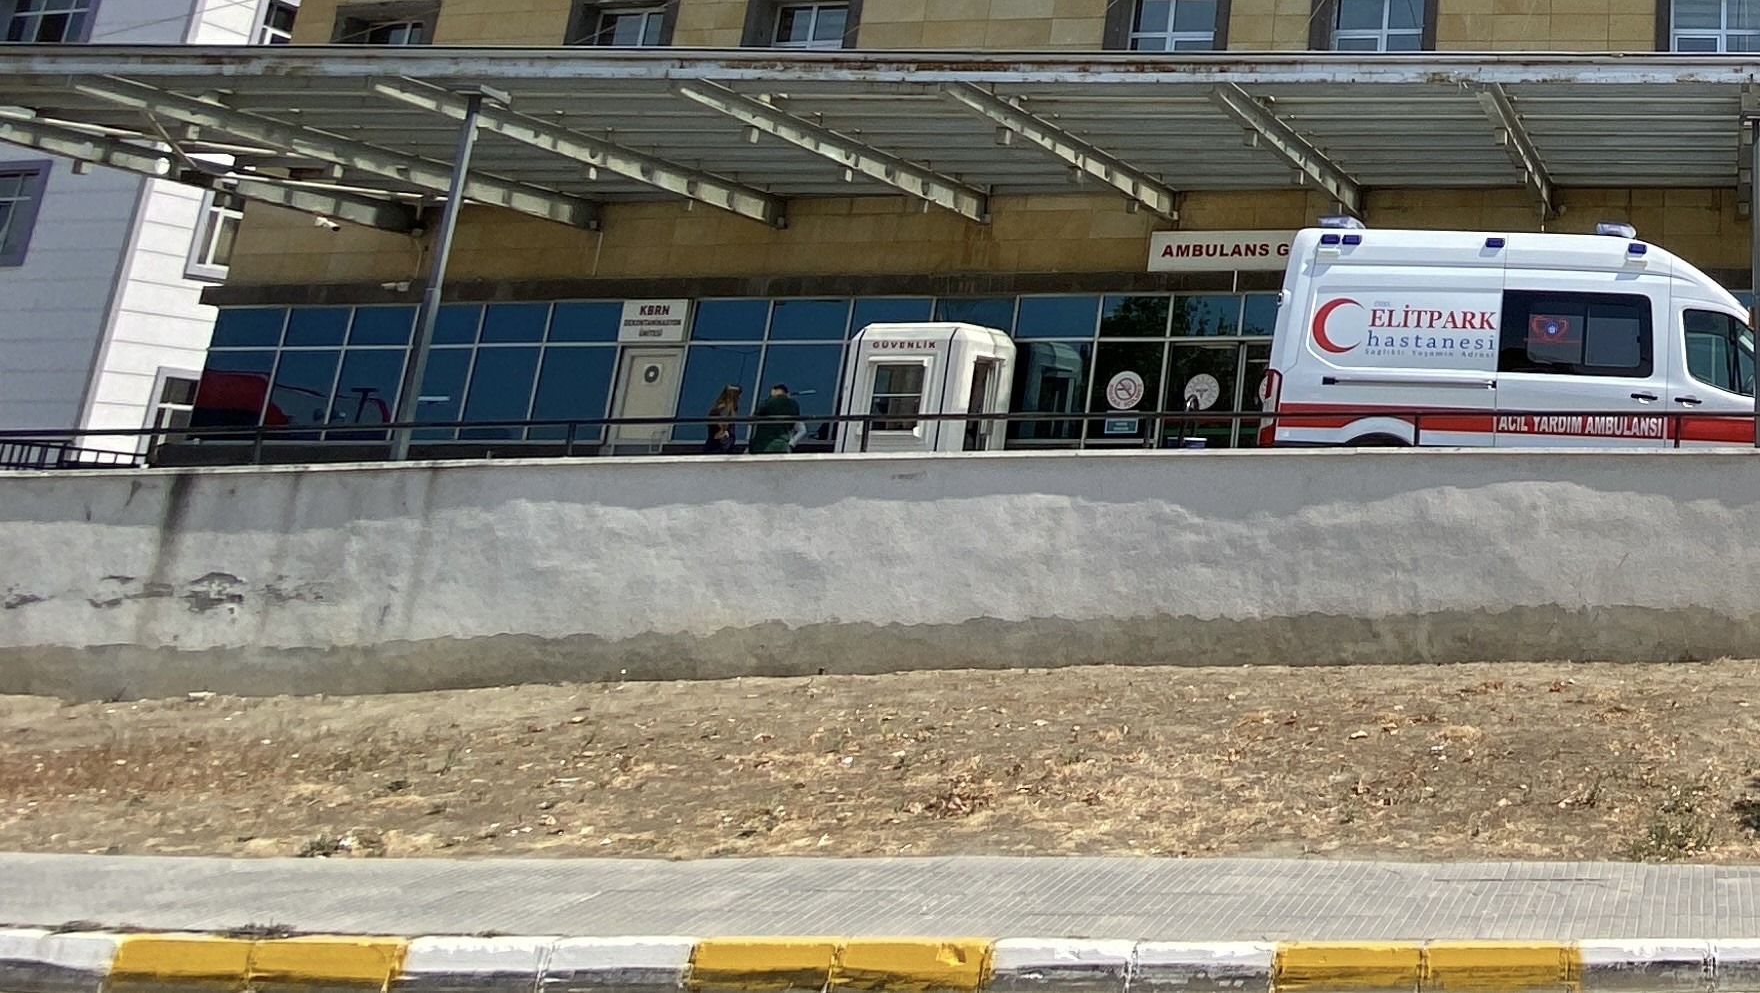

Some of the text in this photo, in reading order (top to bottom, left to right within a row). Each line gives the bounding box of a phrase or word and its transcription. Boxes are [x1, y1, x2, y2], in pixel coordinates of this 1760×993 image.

[1161, 243, 1270, 257] AMBULANS
[1368, 304, 1497, 330] ELİTPARK
[872, 339, 936, 349] GÜVENLİK
[1367, 330, 1496, 351] hastanesi
[1532, 415, 1582, 435] YARDIM
[1585, 416, 1662, 437] AMBULANSI
